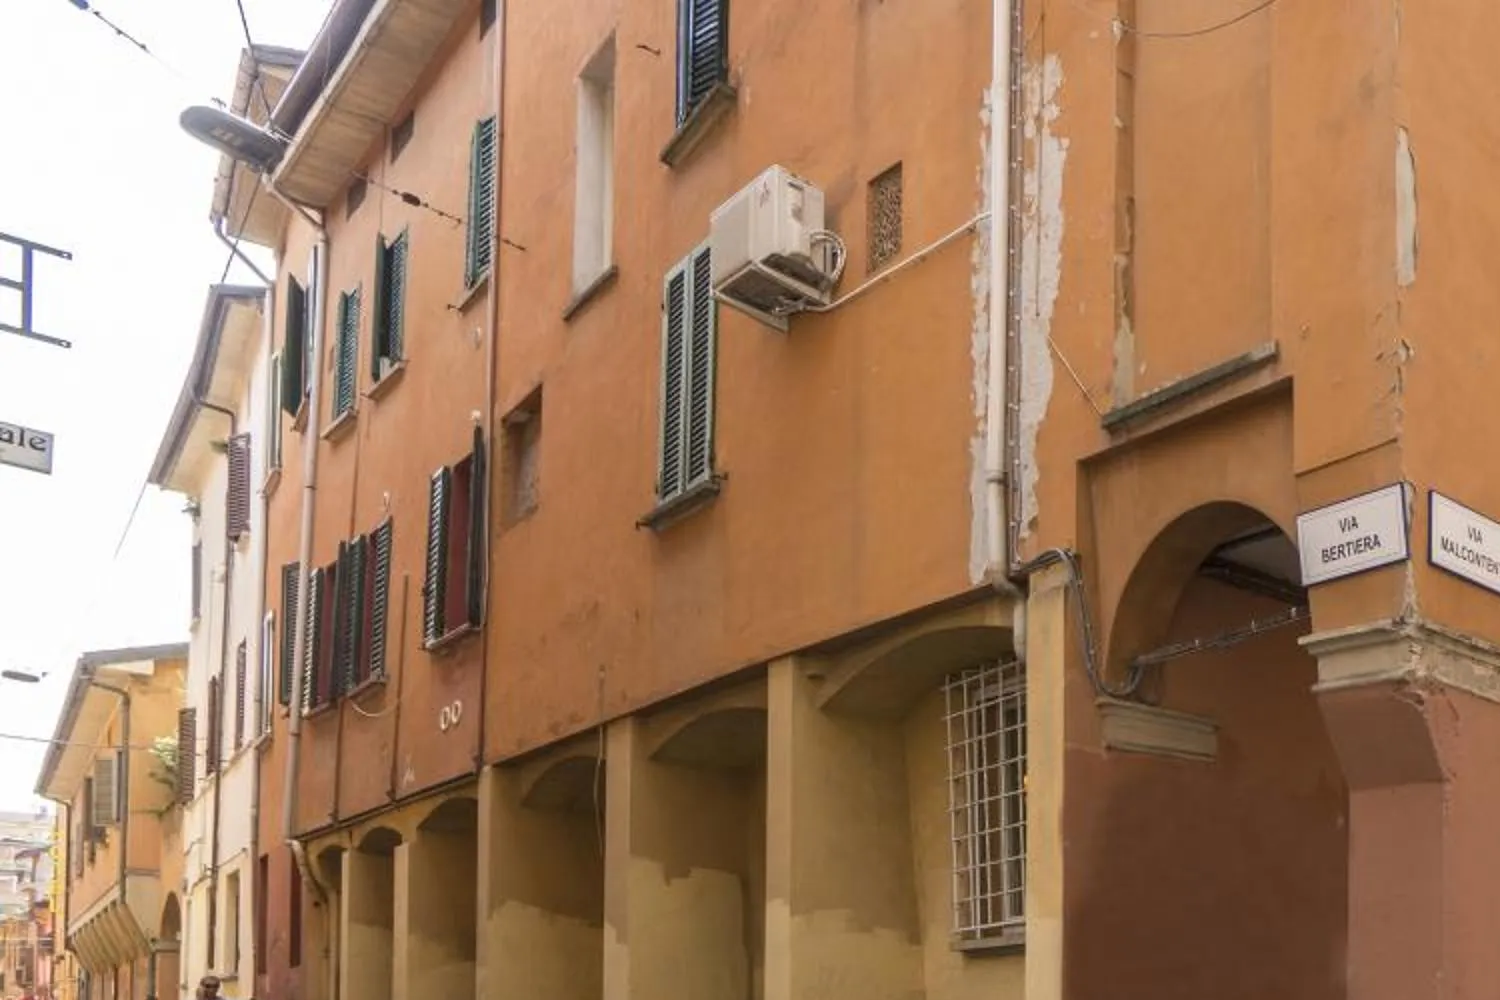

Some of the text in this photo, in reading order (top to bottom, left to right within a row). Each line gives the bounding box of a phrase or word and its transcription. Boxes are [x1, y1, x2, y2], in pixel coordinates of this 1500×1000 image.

[1339, 515, 1359, 533] VIA
[1467, 526, 1483, 545] VIA
[1321, 533, 1381, 563] BERTIERA
